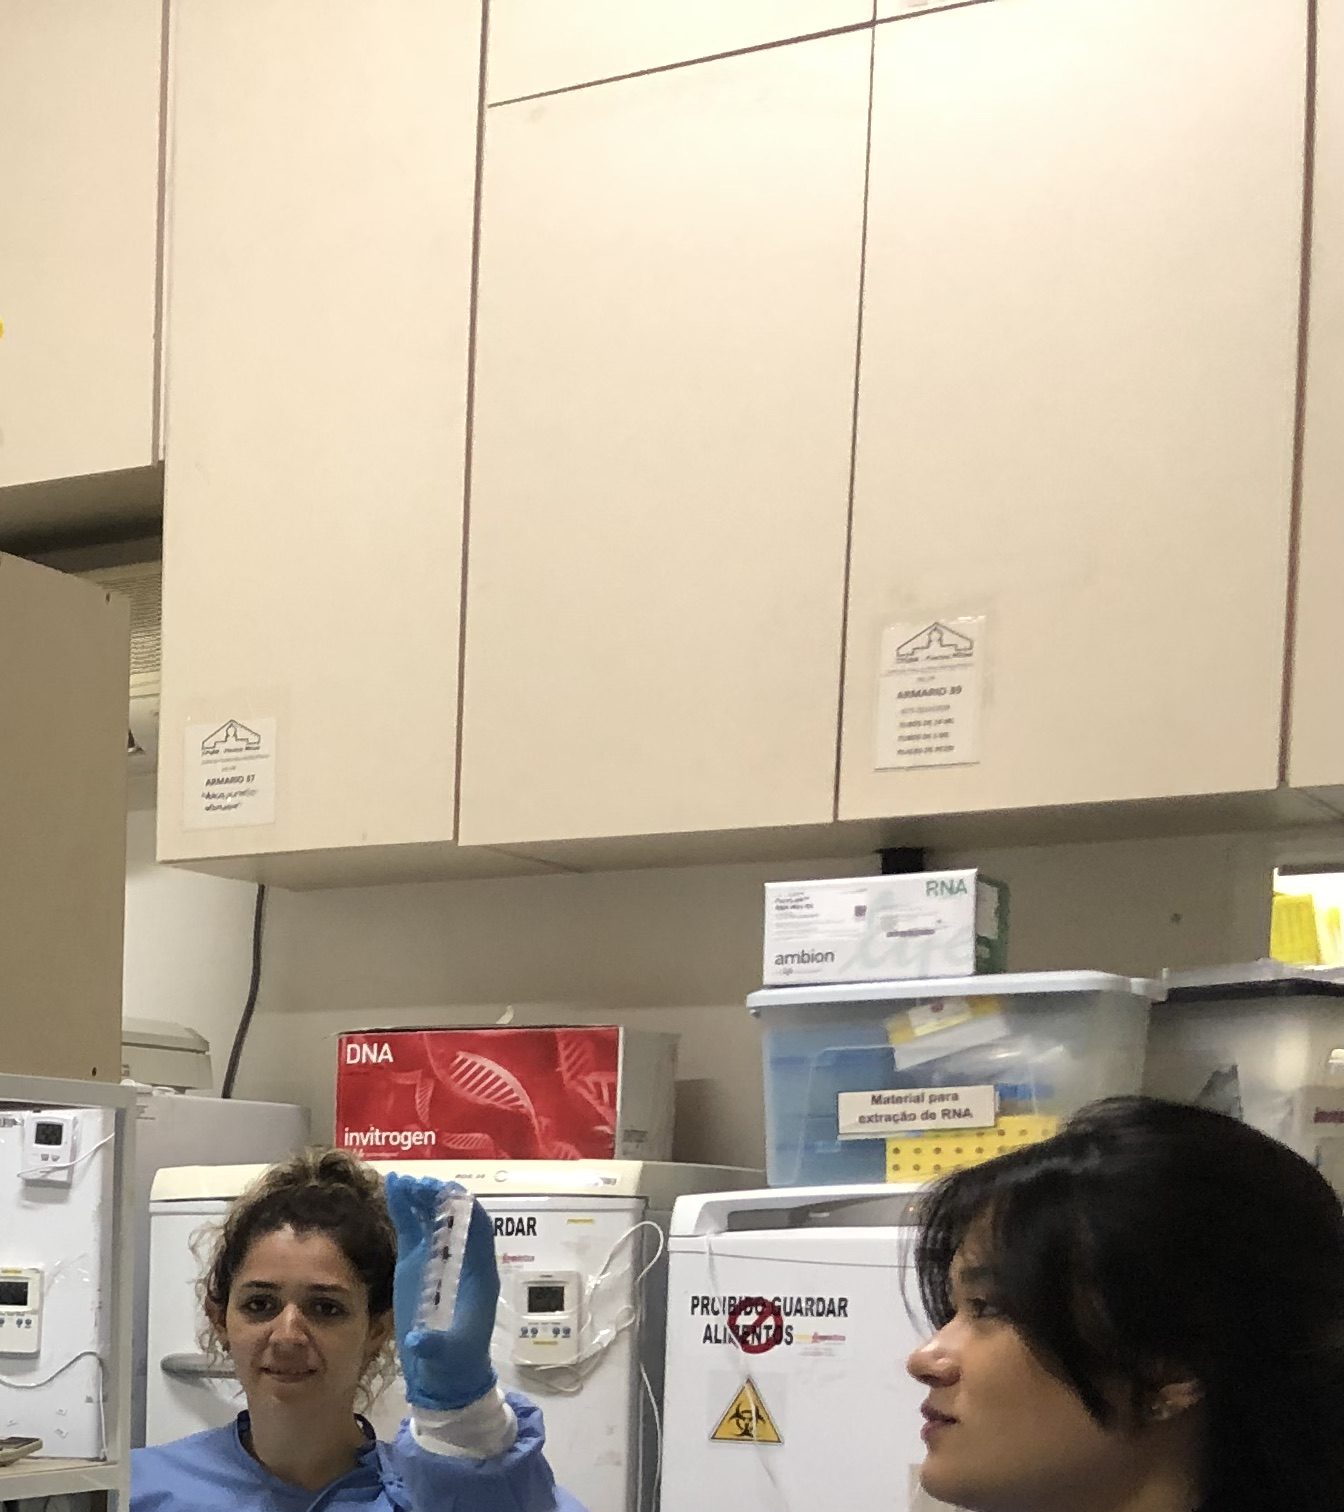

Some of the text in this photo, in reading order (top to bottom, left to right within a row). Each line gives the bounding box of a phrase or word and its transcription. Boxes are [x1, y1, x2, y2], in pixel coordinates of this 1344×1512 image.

[925, 878, 968, 897] RNA
[774, 949, 835, 966] ambion
[345, 1042, 394, 1065] DNA
[870, 1091, 960, 1106] Material para
[858, 1107, 974, 1125] extração de RNA
[343, 1125, 437, 1152] invitrogen
[690, 1295, 849, 1319] PROIBIDO GUARDAR
[702, 1323, 795, 1347] ALIMENTOS
